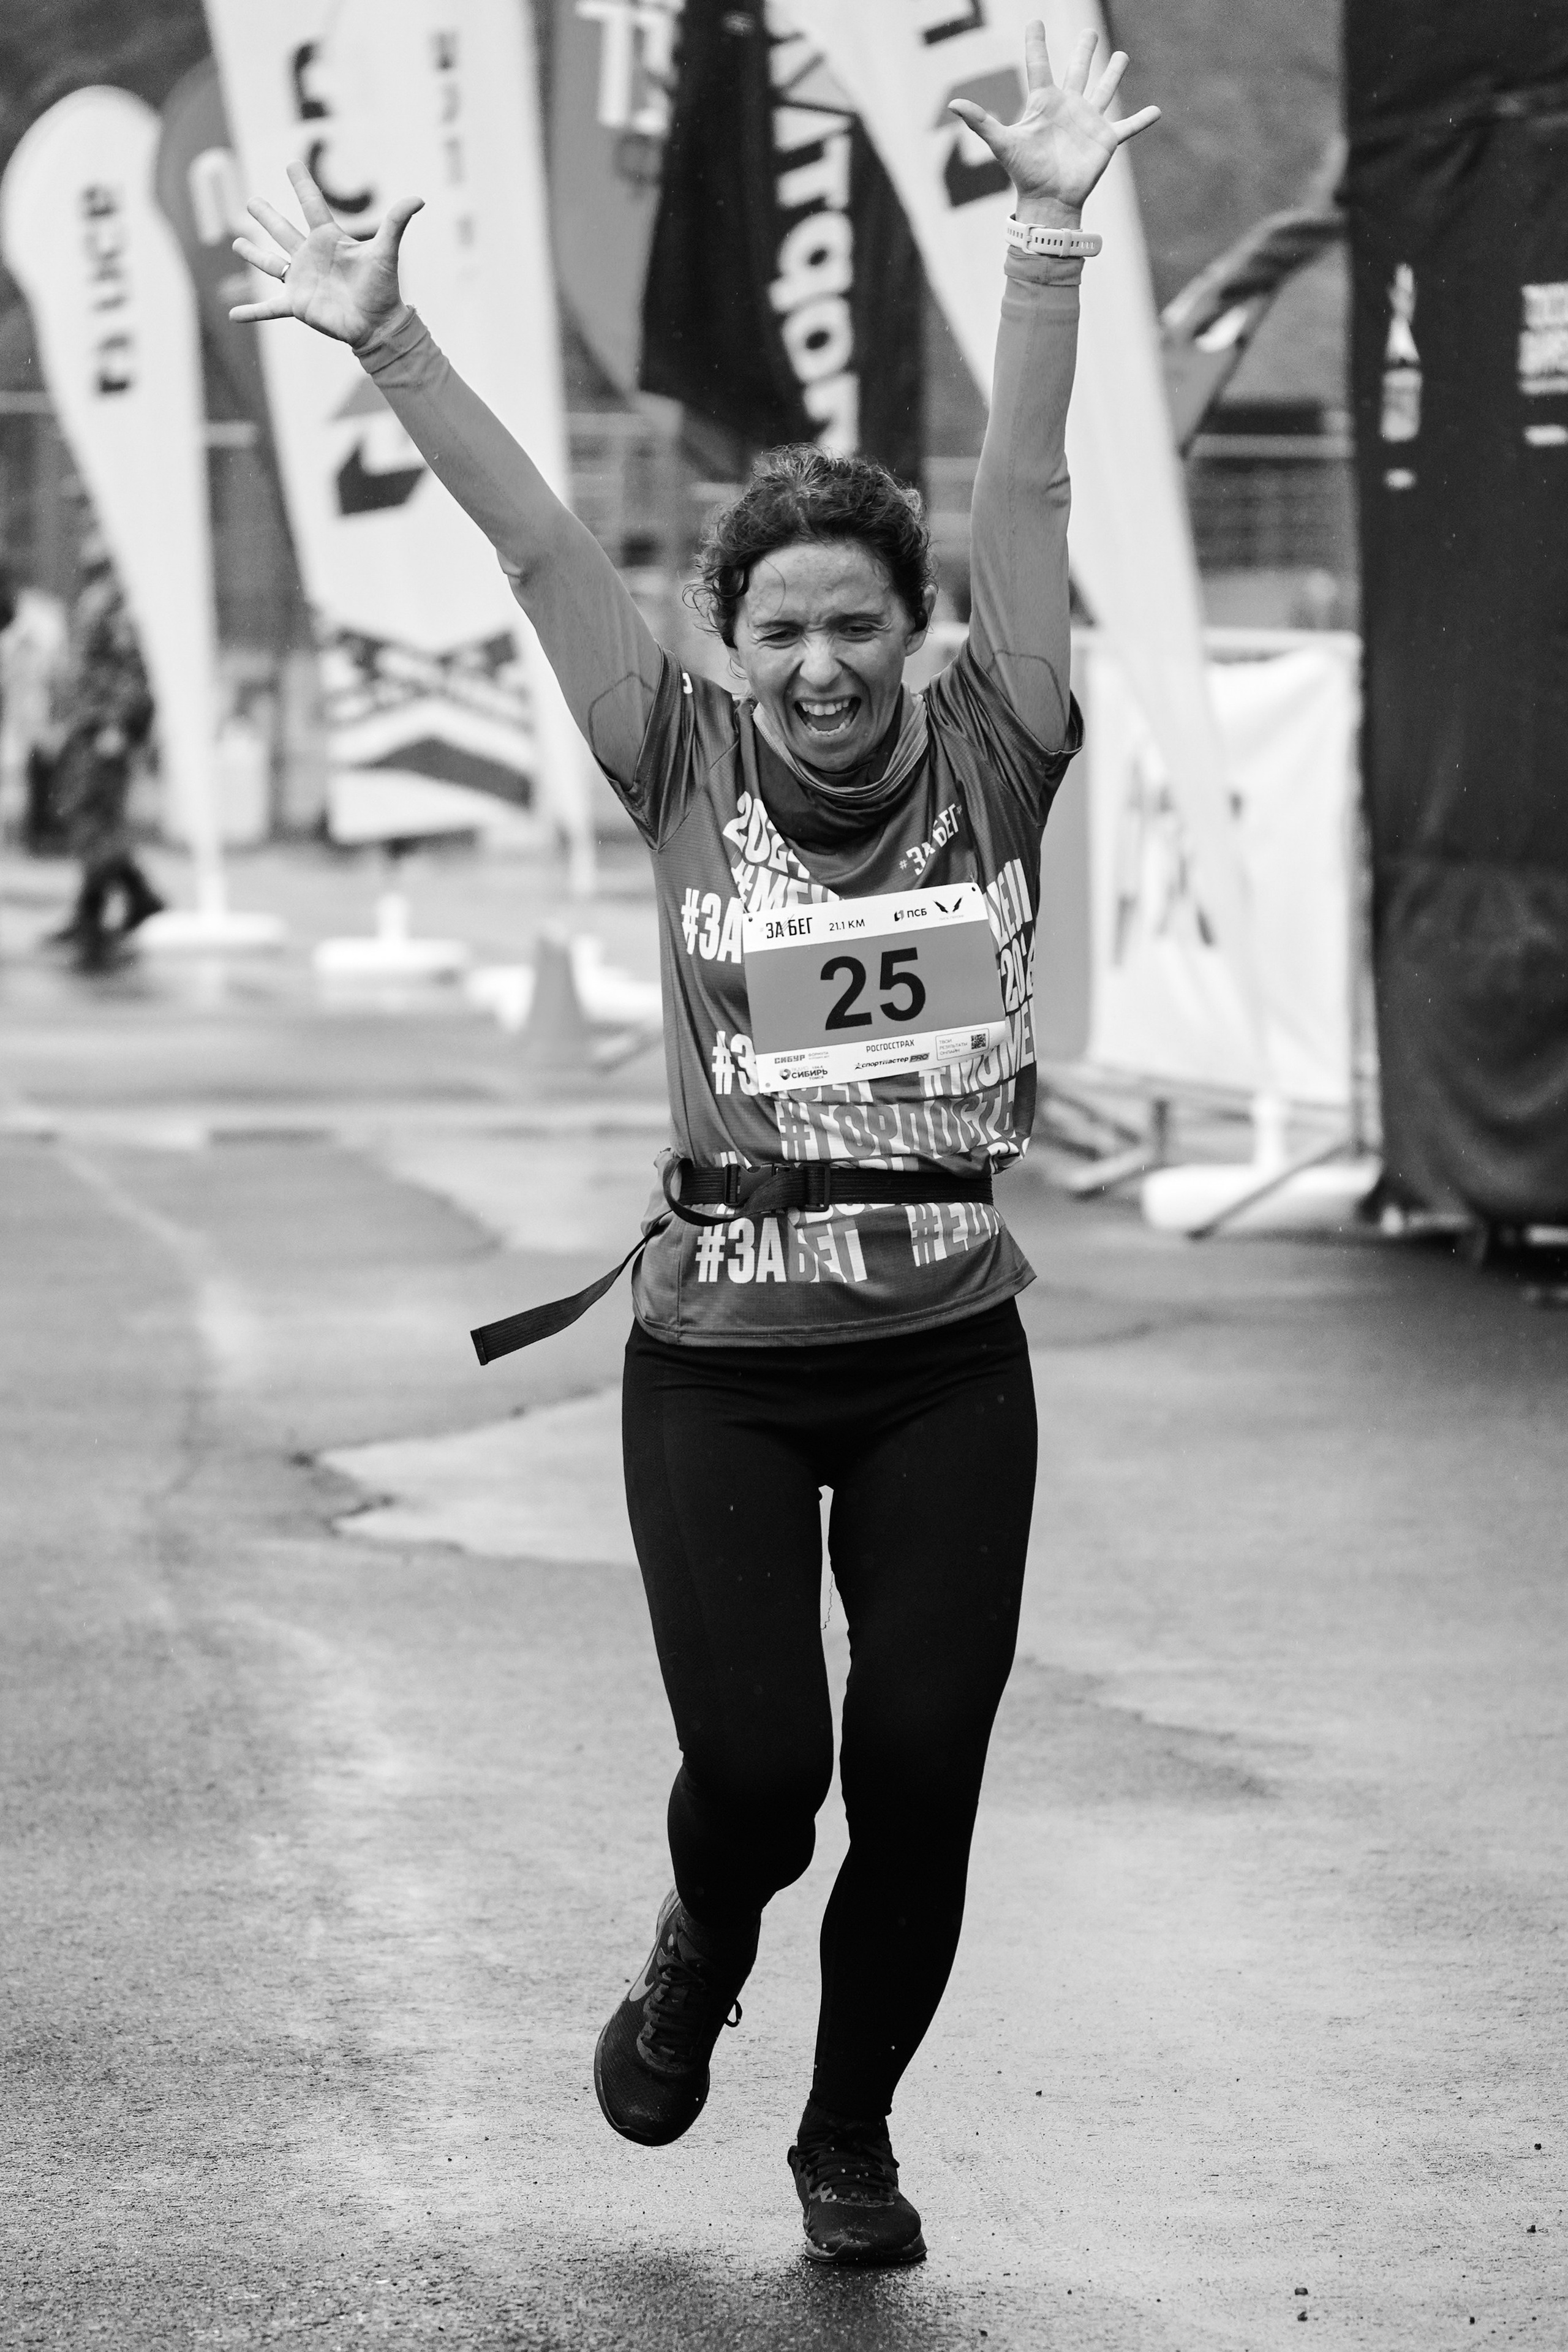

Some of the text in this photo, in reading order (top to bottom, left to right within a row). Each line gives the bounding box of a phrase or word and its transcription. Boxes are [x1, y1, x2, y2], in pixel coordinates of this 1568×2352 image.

[907, 908, 927, 918] ПСБ
[680, 888, 744, 964] #ЗА
[788, 918, 813, 937] БЕГ
[829, 921, 845, 932] 21.1
[819, 947, 926, 1031] 25
[865, 1039, 915, 1053] РОСГОССТРАХ
[774, 1054, 806, 1065] СИБУР
[910, 1053, 929, 1063] PRO
[791, 1068, 828, 1079] СИБИРЬ
